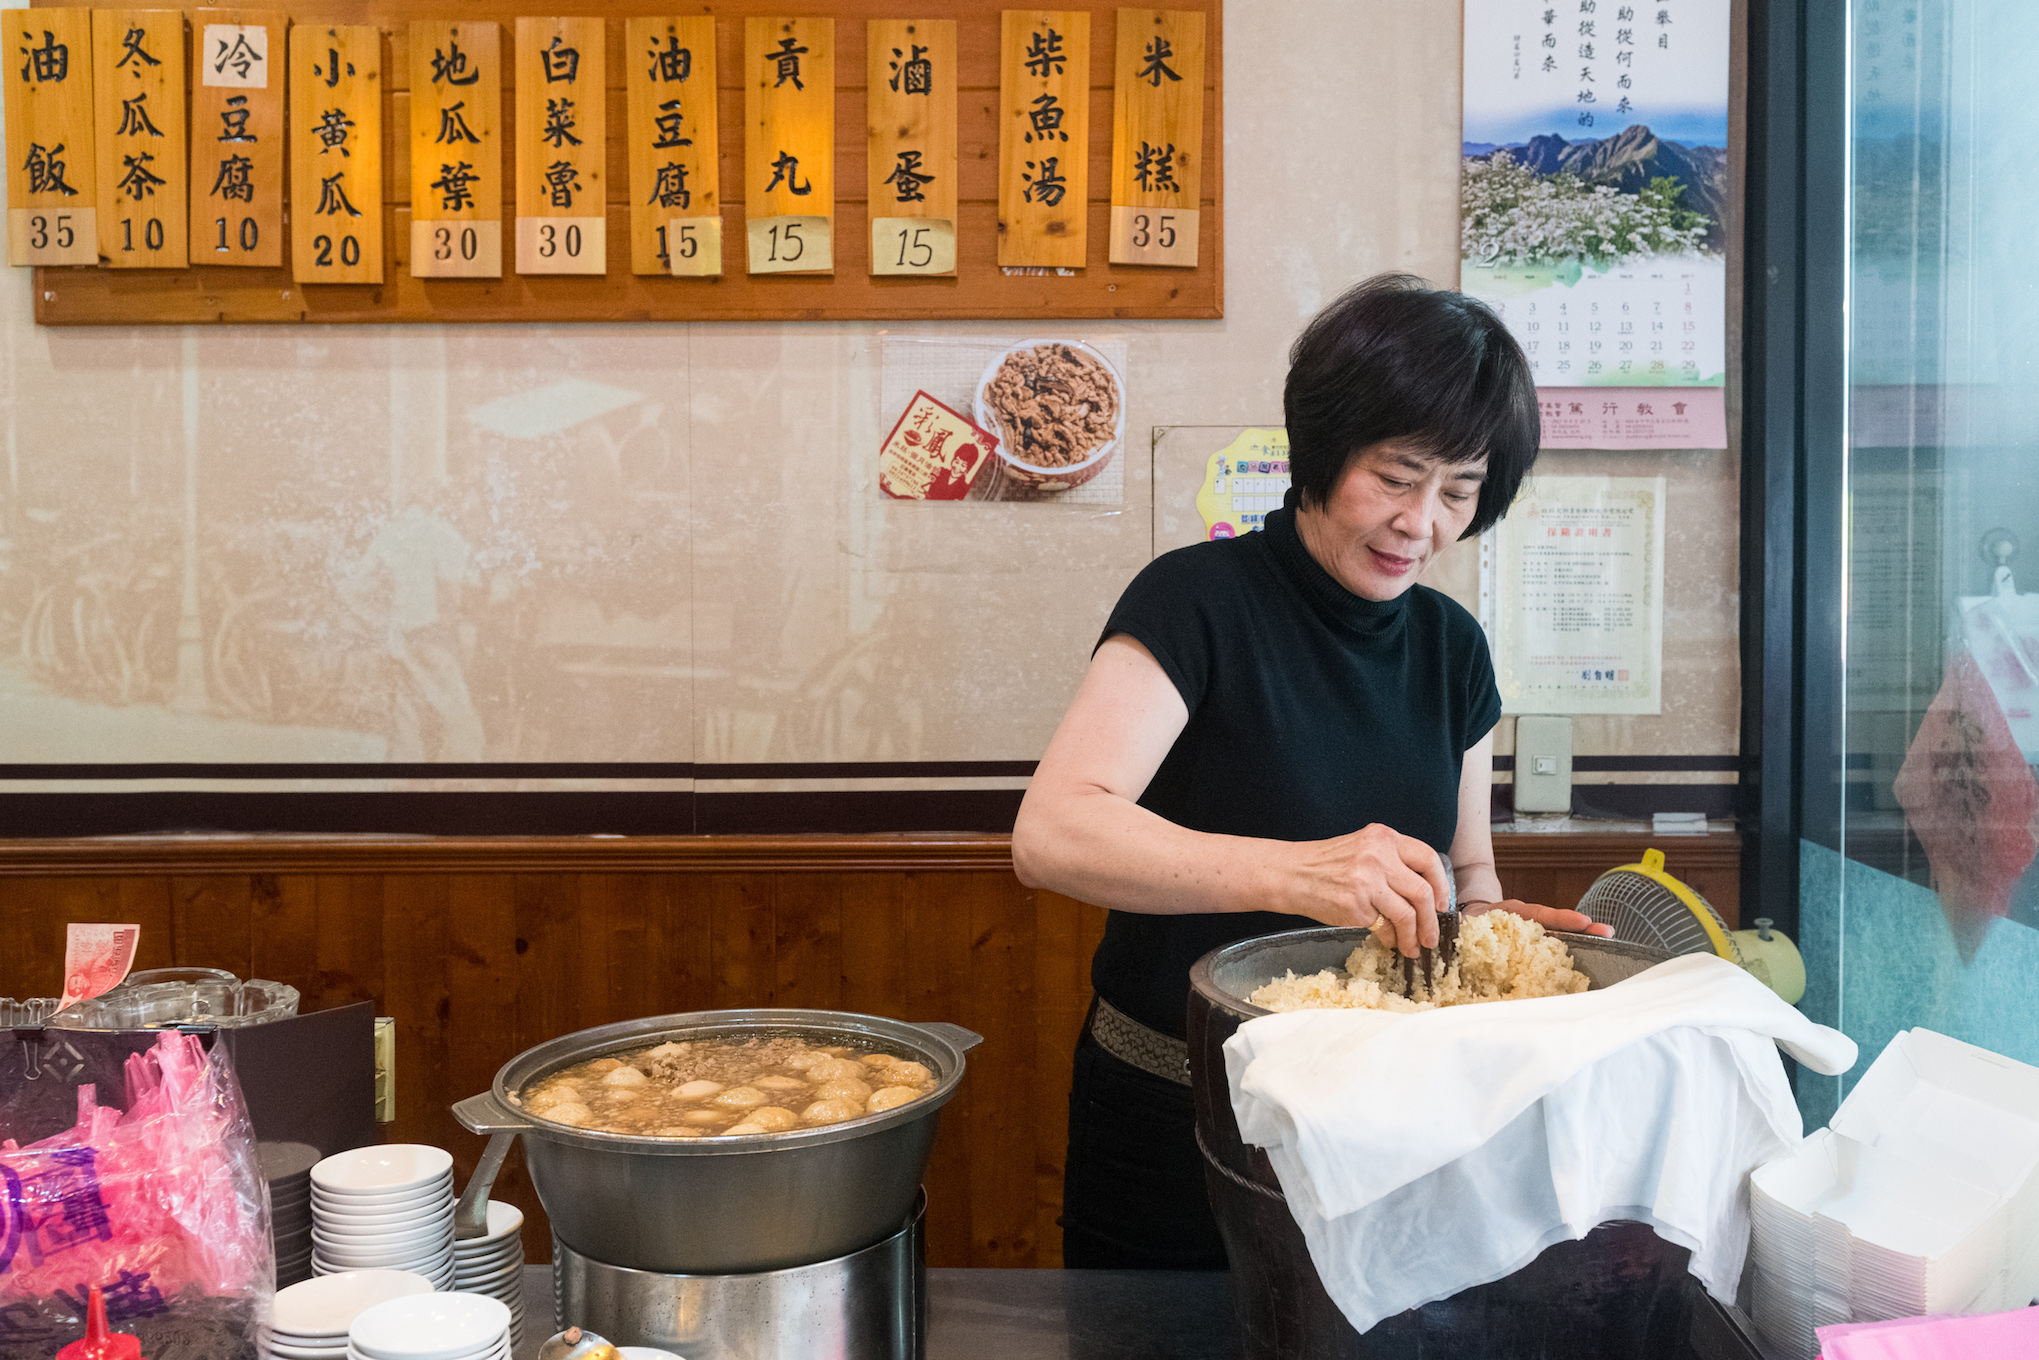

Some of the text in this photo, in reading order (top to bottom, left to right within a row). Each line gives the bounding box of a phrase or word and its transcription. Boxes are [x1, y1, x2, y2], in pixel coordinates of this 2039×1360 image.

[1541, 0, 1558, 73] 華而來
[1655, 0, 1673, 50] 舉目
[19, 30, 79, 197] 油飯
[115, 27, 168, 201] 冬瓜茶
[209, 32, 263, 203] 冷豆腐
[309, 46, 363, 218] 小黃瓜
[430, 41, 481, 213] 地瓜葉
[539, 35, 584, 210] 白菜魯
[647, 36, 693, 209] 油豆腐
[764, 37, 812, 196] 貢丸
[883, 44, 936, 203] 滷蛋
[1021, 28, 1069, 208] 柴魚湯
[1133, 35, 1184, 194] 米糕
[30, 215, 76, 250] 35
[120, 217, 165, 252] 10
[214, 216, 260, 252] 10
[313, 234, 361, 268] 20
[433, 227, 478, 261] 30
[538, 224, 583, 259] 30
[655, 225, 698, 259] 15
[766, 224, 805, 263] 15
[896, 228, 934, 267] 15
[1132, 215, 1178, 249] 35
[1527, 322, 1695, 331] 10 11 12 13 14 15
[1530, 302, 1536, 312] 3
[1560, 302, 1566, 312] 4
[1592, 302, 1598, 312] 5
[1622, 302, 1629, 312] 6
[1654, 302, 1660, 312] 7
[1685, 302, 1691, 312] 8
[1527, 341, 1695, 350] 17 18 19 20 21 22
[1557, 360, 1570, 370] 25
[1588, 360, 1602, 370] 26
[1620, 360, 1632, 370] 27
[1650, 360, 1664, 370] 28
[1682, 360, 1695, 370] 29
